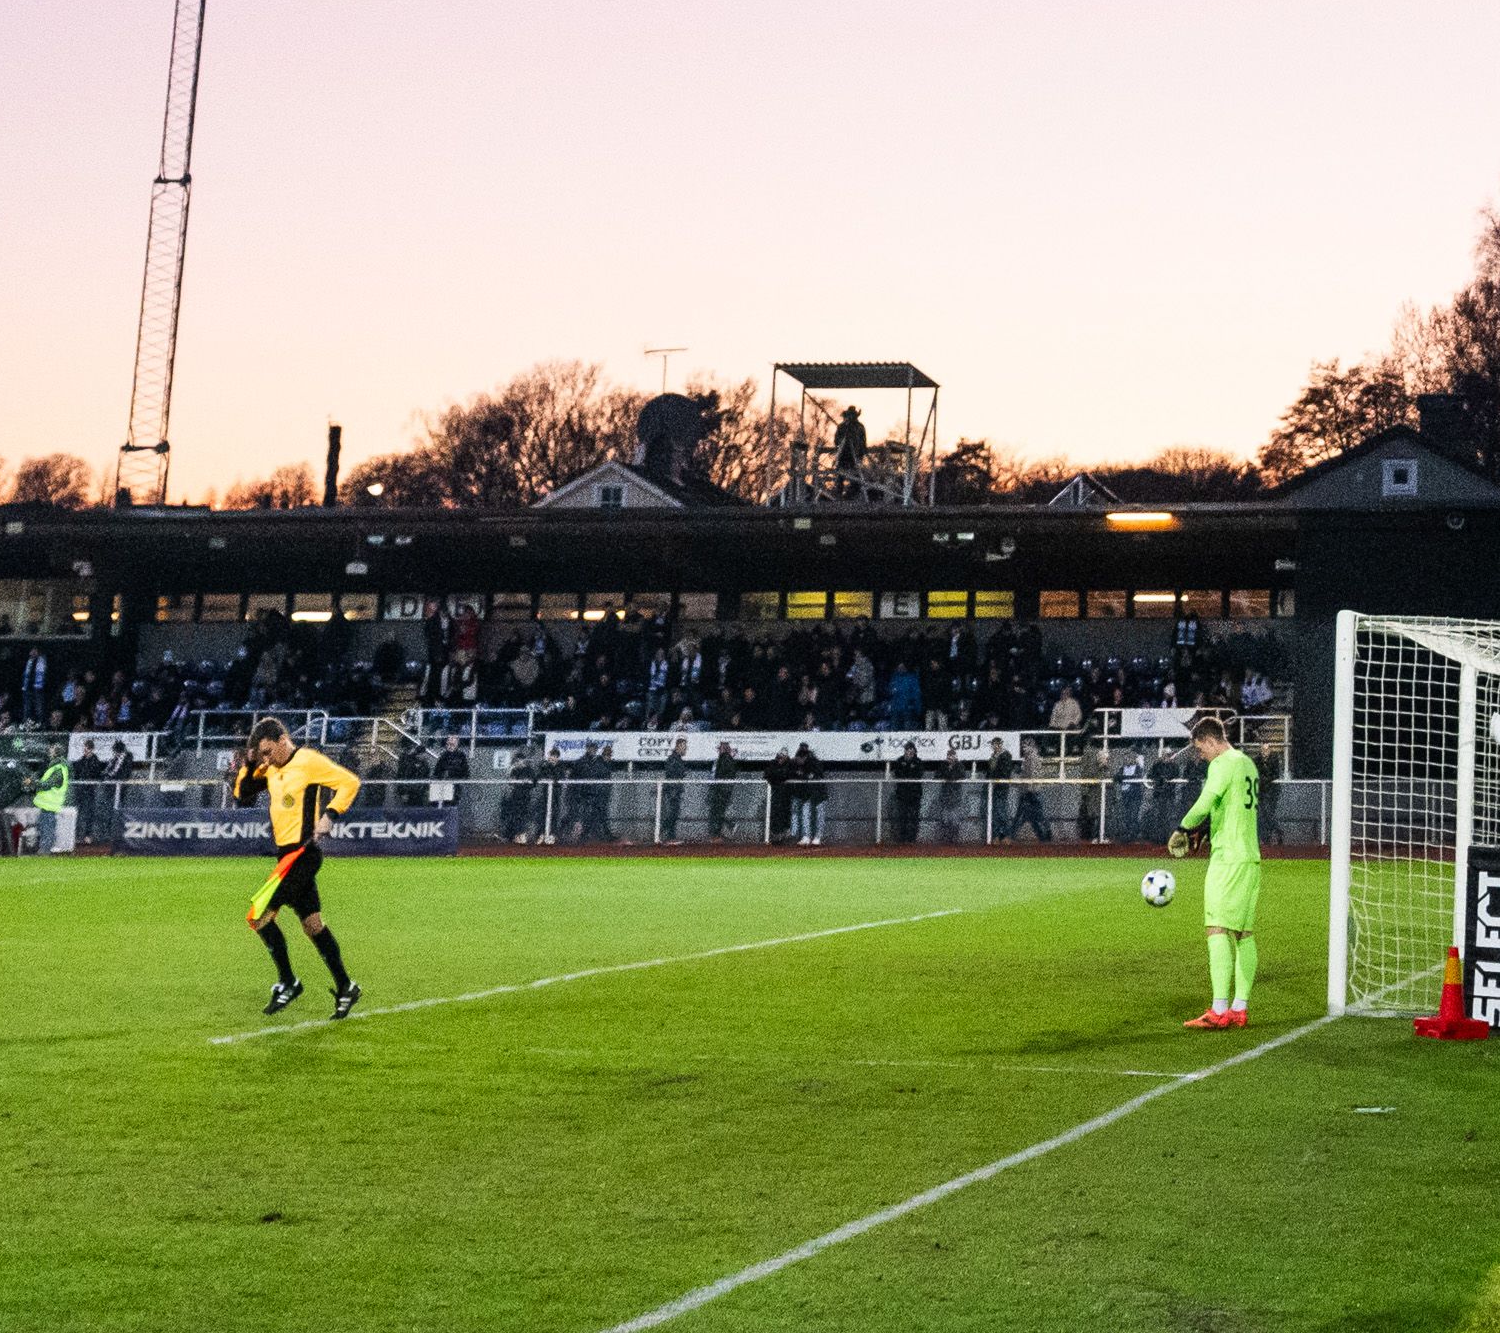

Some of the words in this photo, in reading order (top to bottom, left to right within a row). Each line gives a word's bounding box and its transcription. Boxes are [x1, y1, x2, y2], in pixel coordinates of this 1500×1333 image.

[400, 596, 417, 617] D
[894, 595, 907, 616] E
[638, 737, 674, 747] COPY
[948, 735, 982, 750] GBJ
[638, 748, 672, 758] CENT
[124, 821, 271, 840] ZINKTEKNIK
